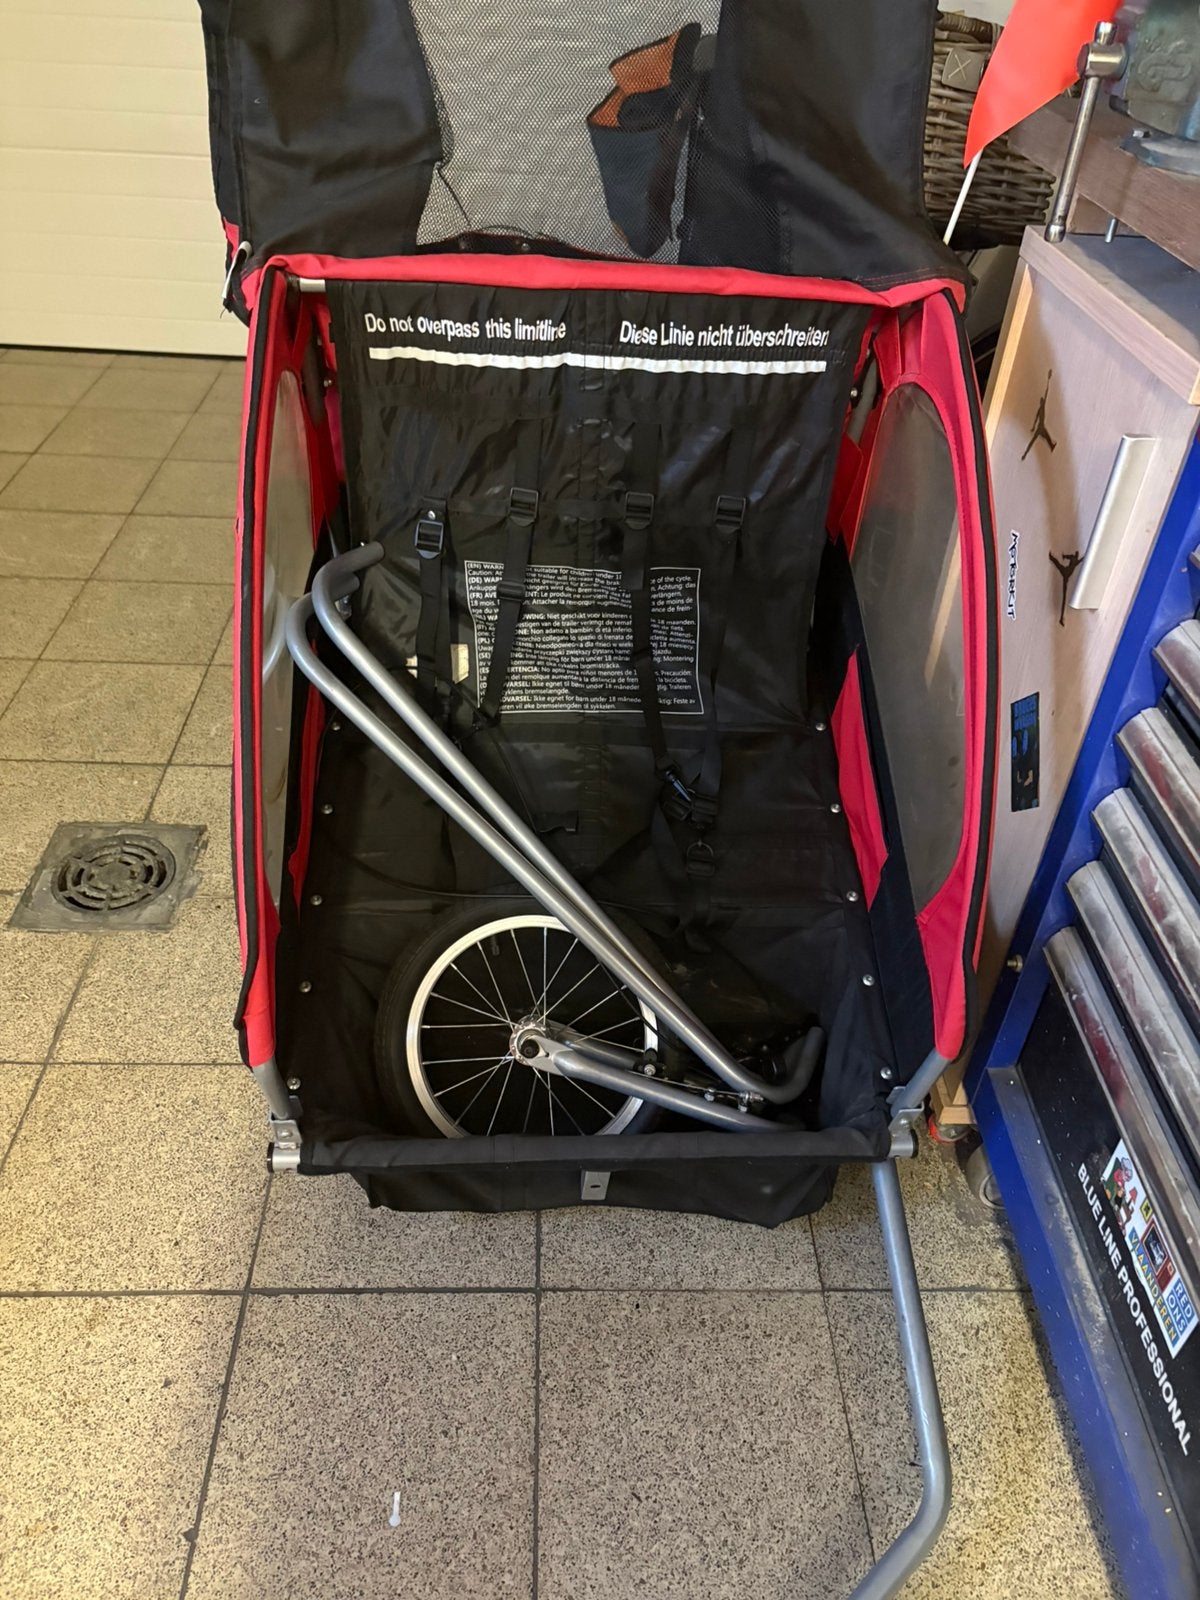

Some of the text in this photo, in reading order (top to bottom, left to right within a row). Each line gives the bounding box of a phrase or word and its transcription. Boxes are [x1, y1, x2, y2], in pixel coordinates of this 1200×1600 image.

[364, 313, 386, 333] Do
[389, 316, 414, 333] not
[417, 317, 480, 342] overpass
[485, 318, 512, 339] this
[619, 321, 829, 347] Diese Linie nicht überschreiten
[468, 576, 483, 585] (DE)
[657, 576, 663, 584] of
[469, 591, 483, 600] (FR)
[602, 611, 628, 619] kinderen
[479, 652, 491, 660] (SE)
[547, 695, 565, 703] egnet
[1131, 1232, 1177, 1342] VLAANDEREN
[1078, 1163, 1191, 1457] BLUE LINE PROFESSIONAL
[1176, 1283, 1194, 1320] RED
[1168, 1294, 1187, 1333] ONS
